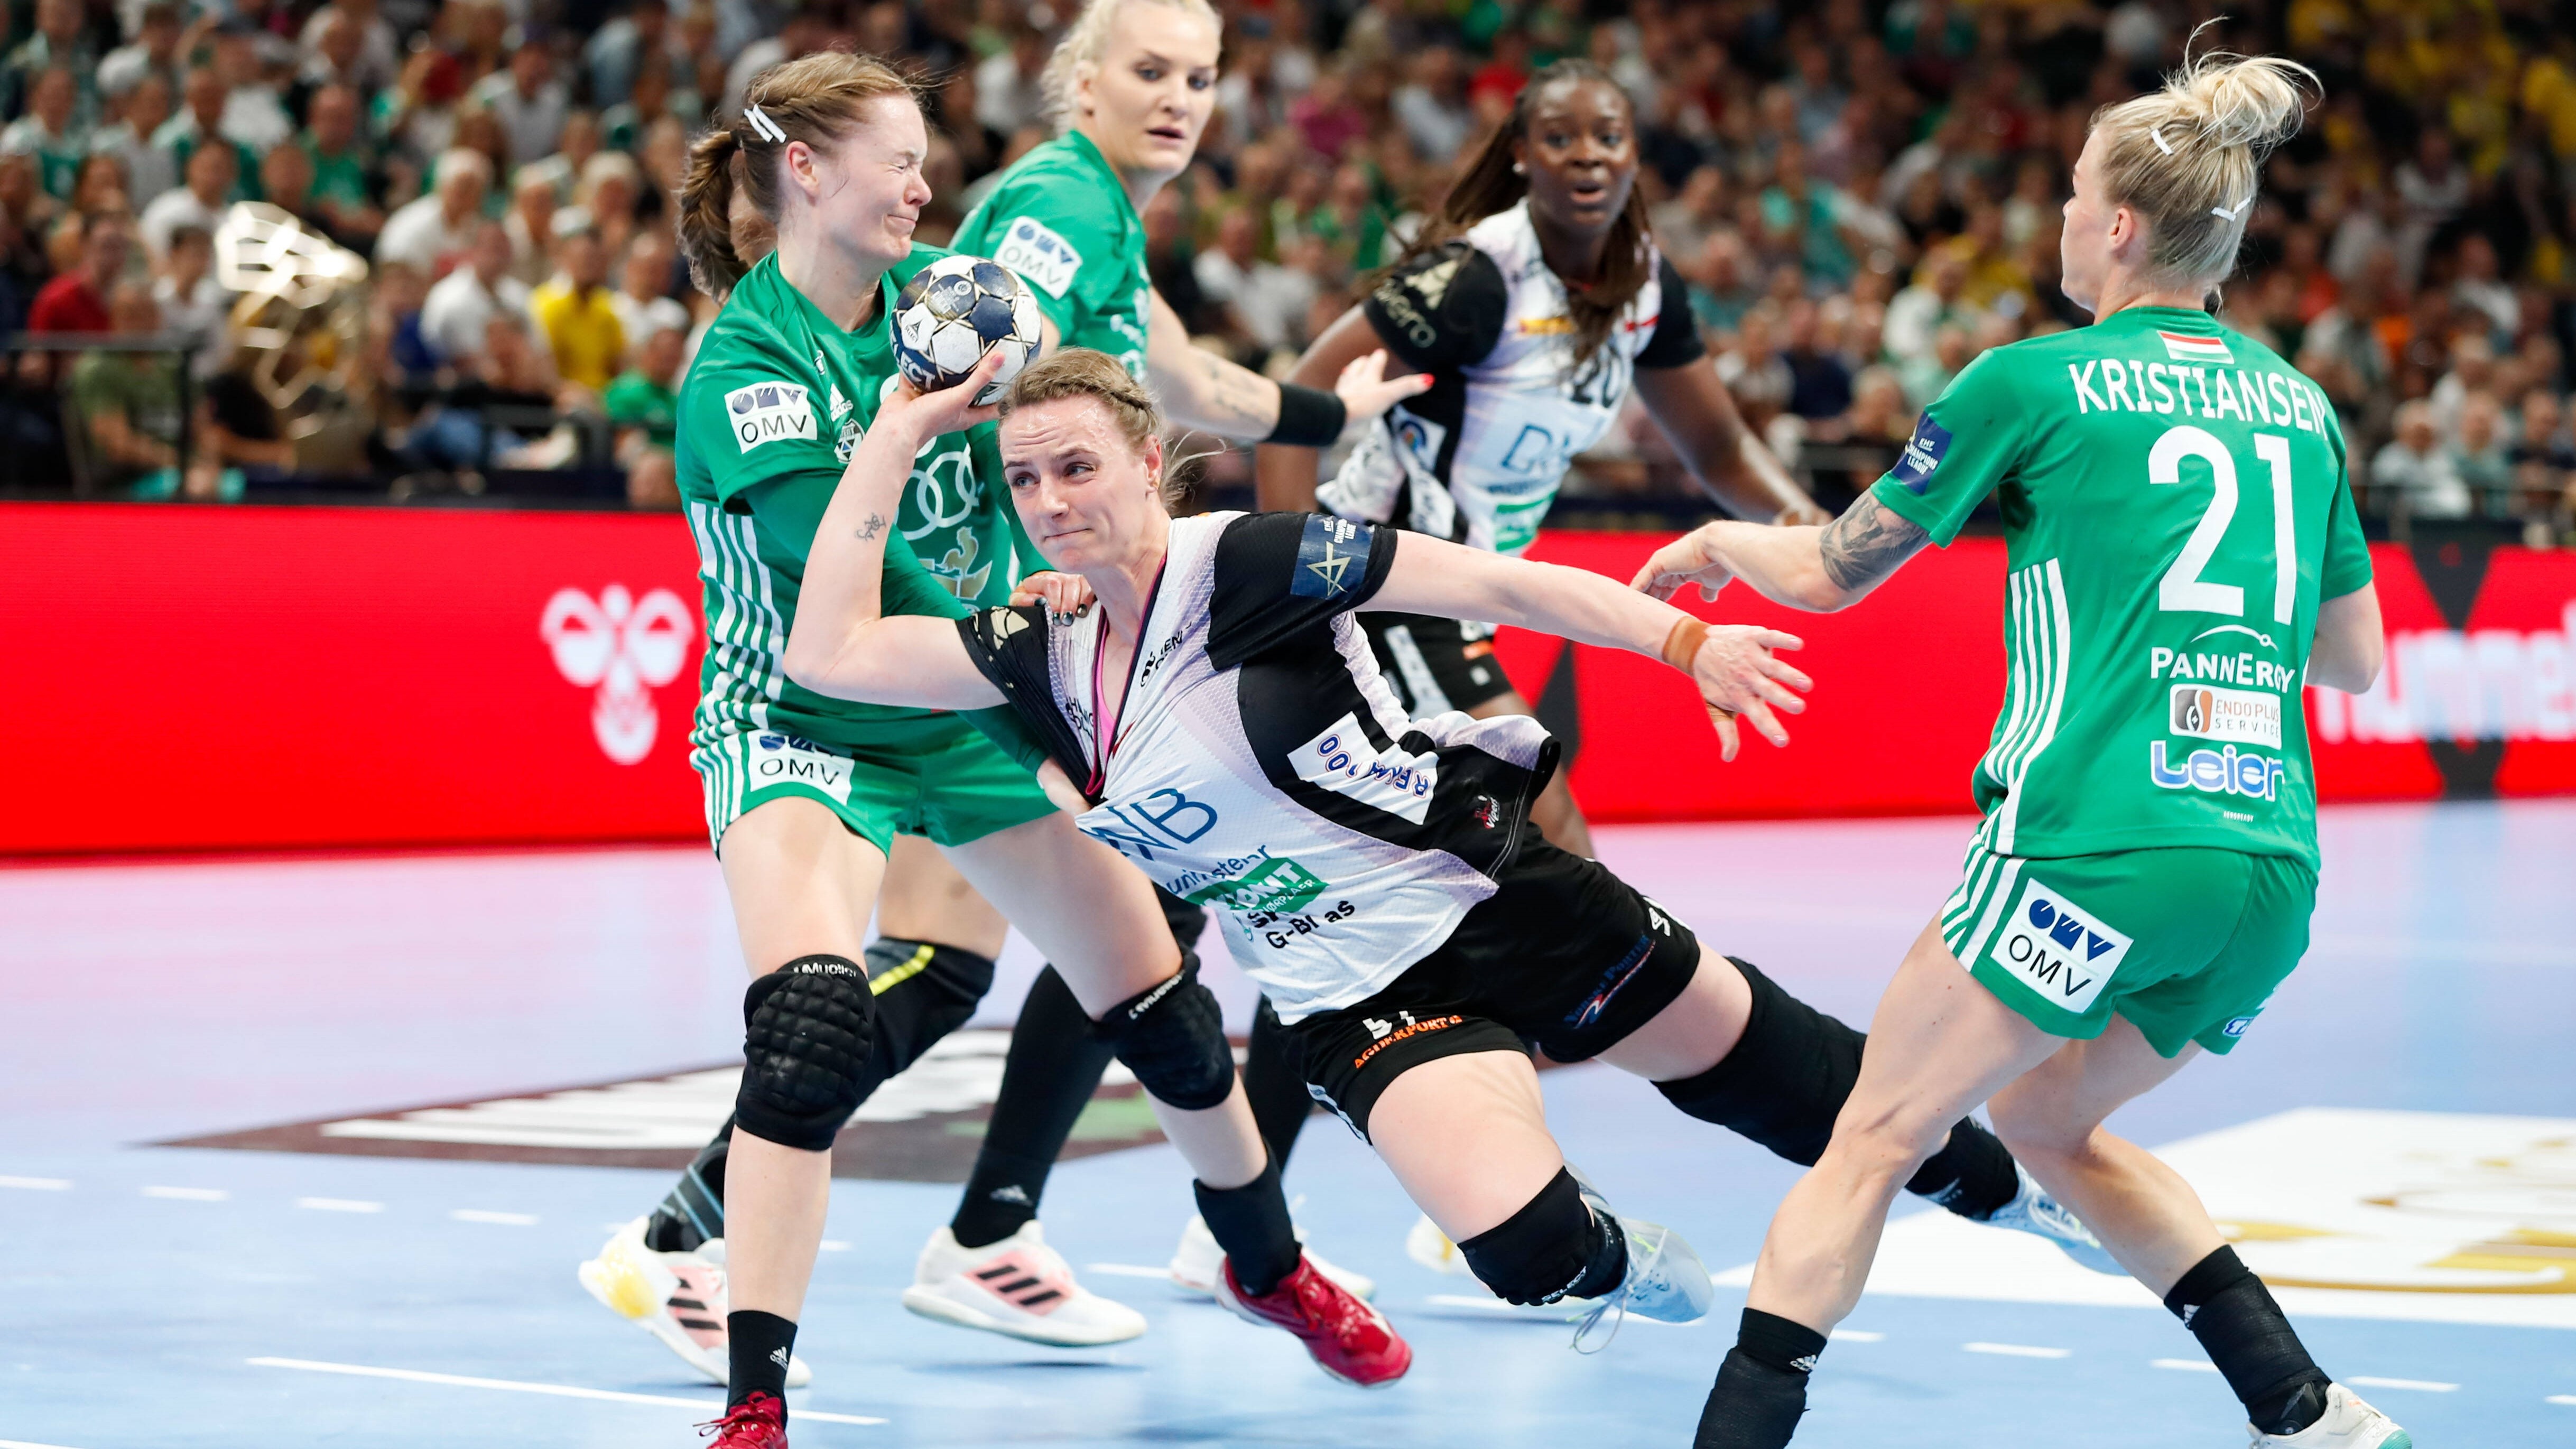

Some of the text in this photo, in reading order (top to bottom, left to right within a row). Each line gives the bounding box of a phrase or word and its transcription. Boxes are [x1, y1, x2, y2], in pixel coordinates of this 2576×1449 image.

[1004, 246, 1063, 285] OMV
[2069, 358, 2328, 441] KRISTIANSEN
[741, 414, 807, 443] OMV
[1907, 444, 1939, 470] HAMPIONS
[1907, 456, 1929, 476] LEAGUE
[2147, 425, 2297, 626] 21
[2215, 718, 2279, 739] SERVICE
[760, 758, 840, 785] OMV
[2151, 740, 2285, 802] Leier
[2009, 934, 2092, 997] OMV
[1541, 1266, 1587, 1303] SELECT
